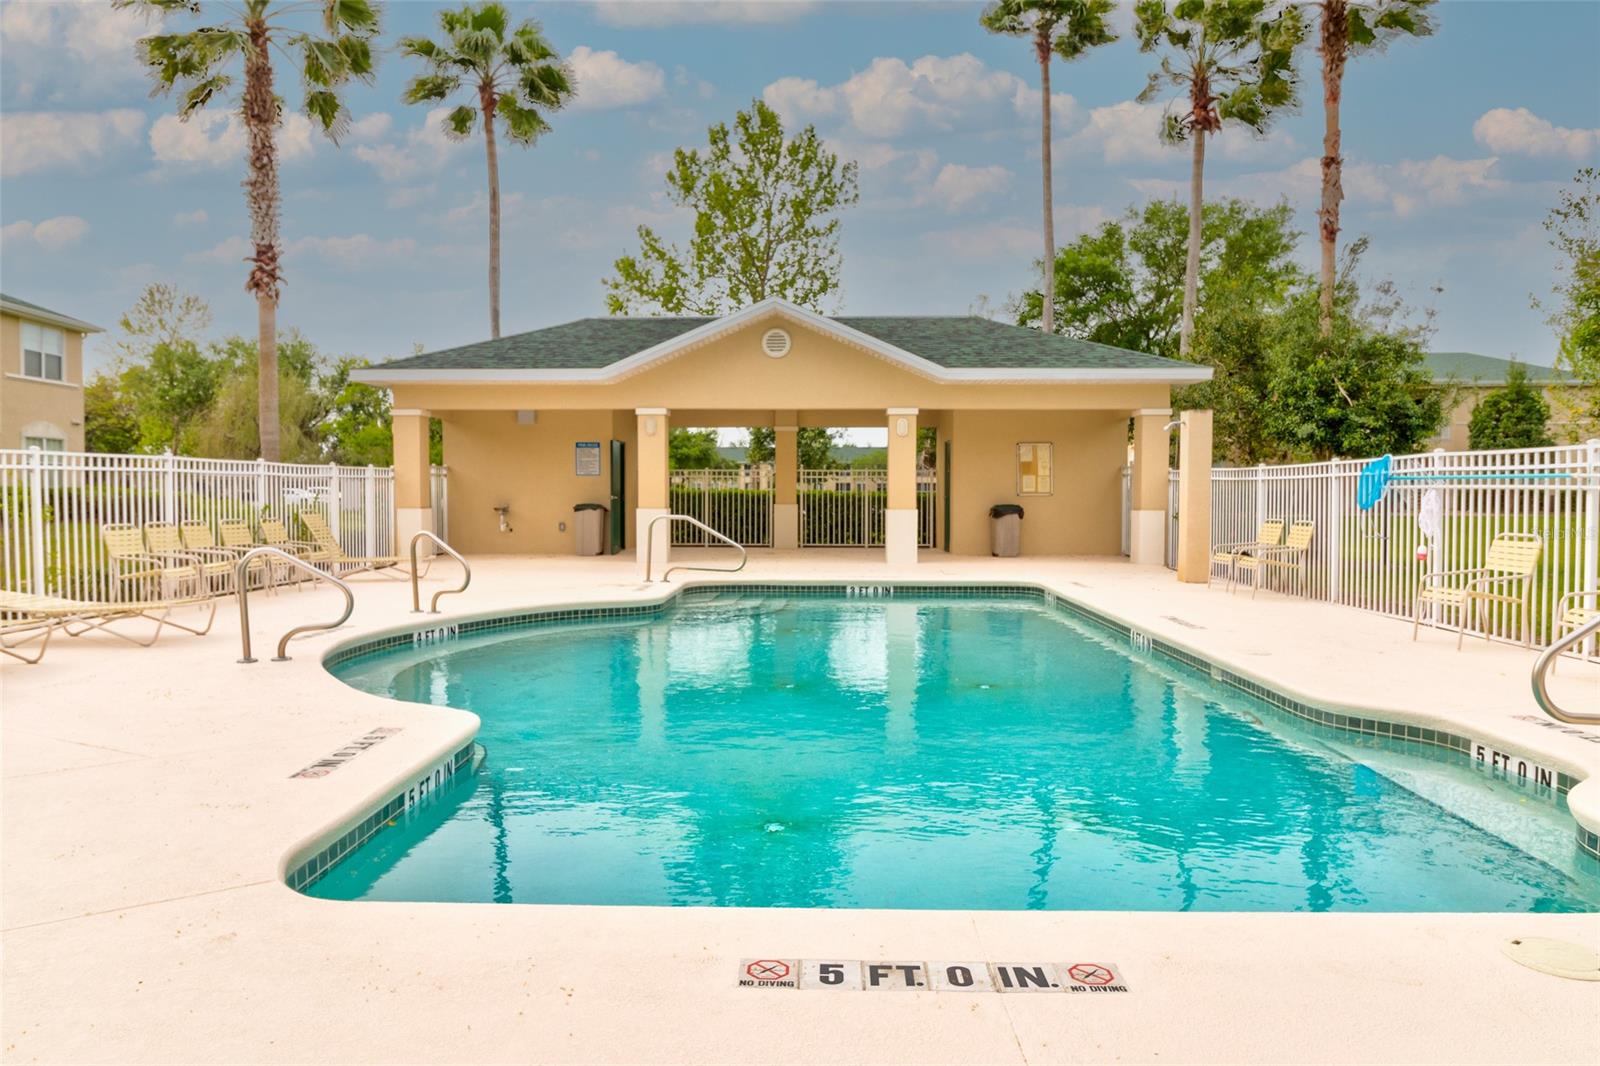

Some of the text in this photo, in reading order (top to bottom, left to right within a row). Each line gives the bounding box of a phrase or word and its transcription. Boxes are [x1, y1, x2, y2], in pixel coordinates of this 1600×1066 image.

[417, 632, 422, 641] 4
[425, 630, 435, 639] FT
[447, 626, 456, 636] IN
[1476, 745, 1552, 788] 5 FT 0 IN
[409, 760, 453, 808] 5 FT 0 IN
[739, 979, 795, 988] NO DIVING
[819, 963, 1060, 988] 5 FT. 0 IN.
[1070, 984, 1128, 993] NO DIVING
